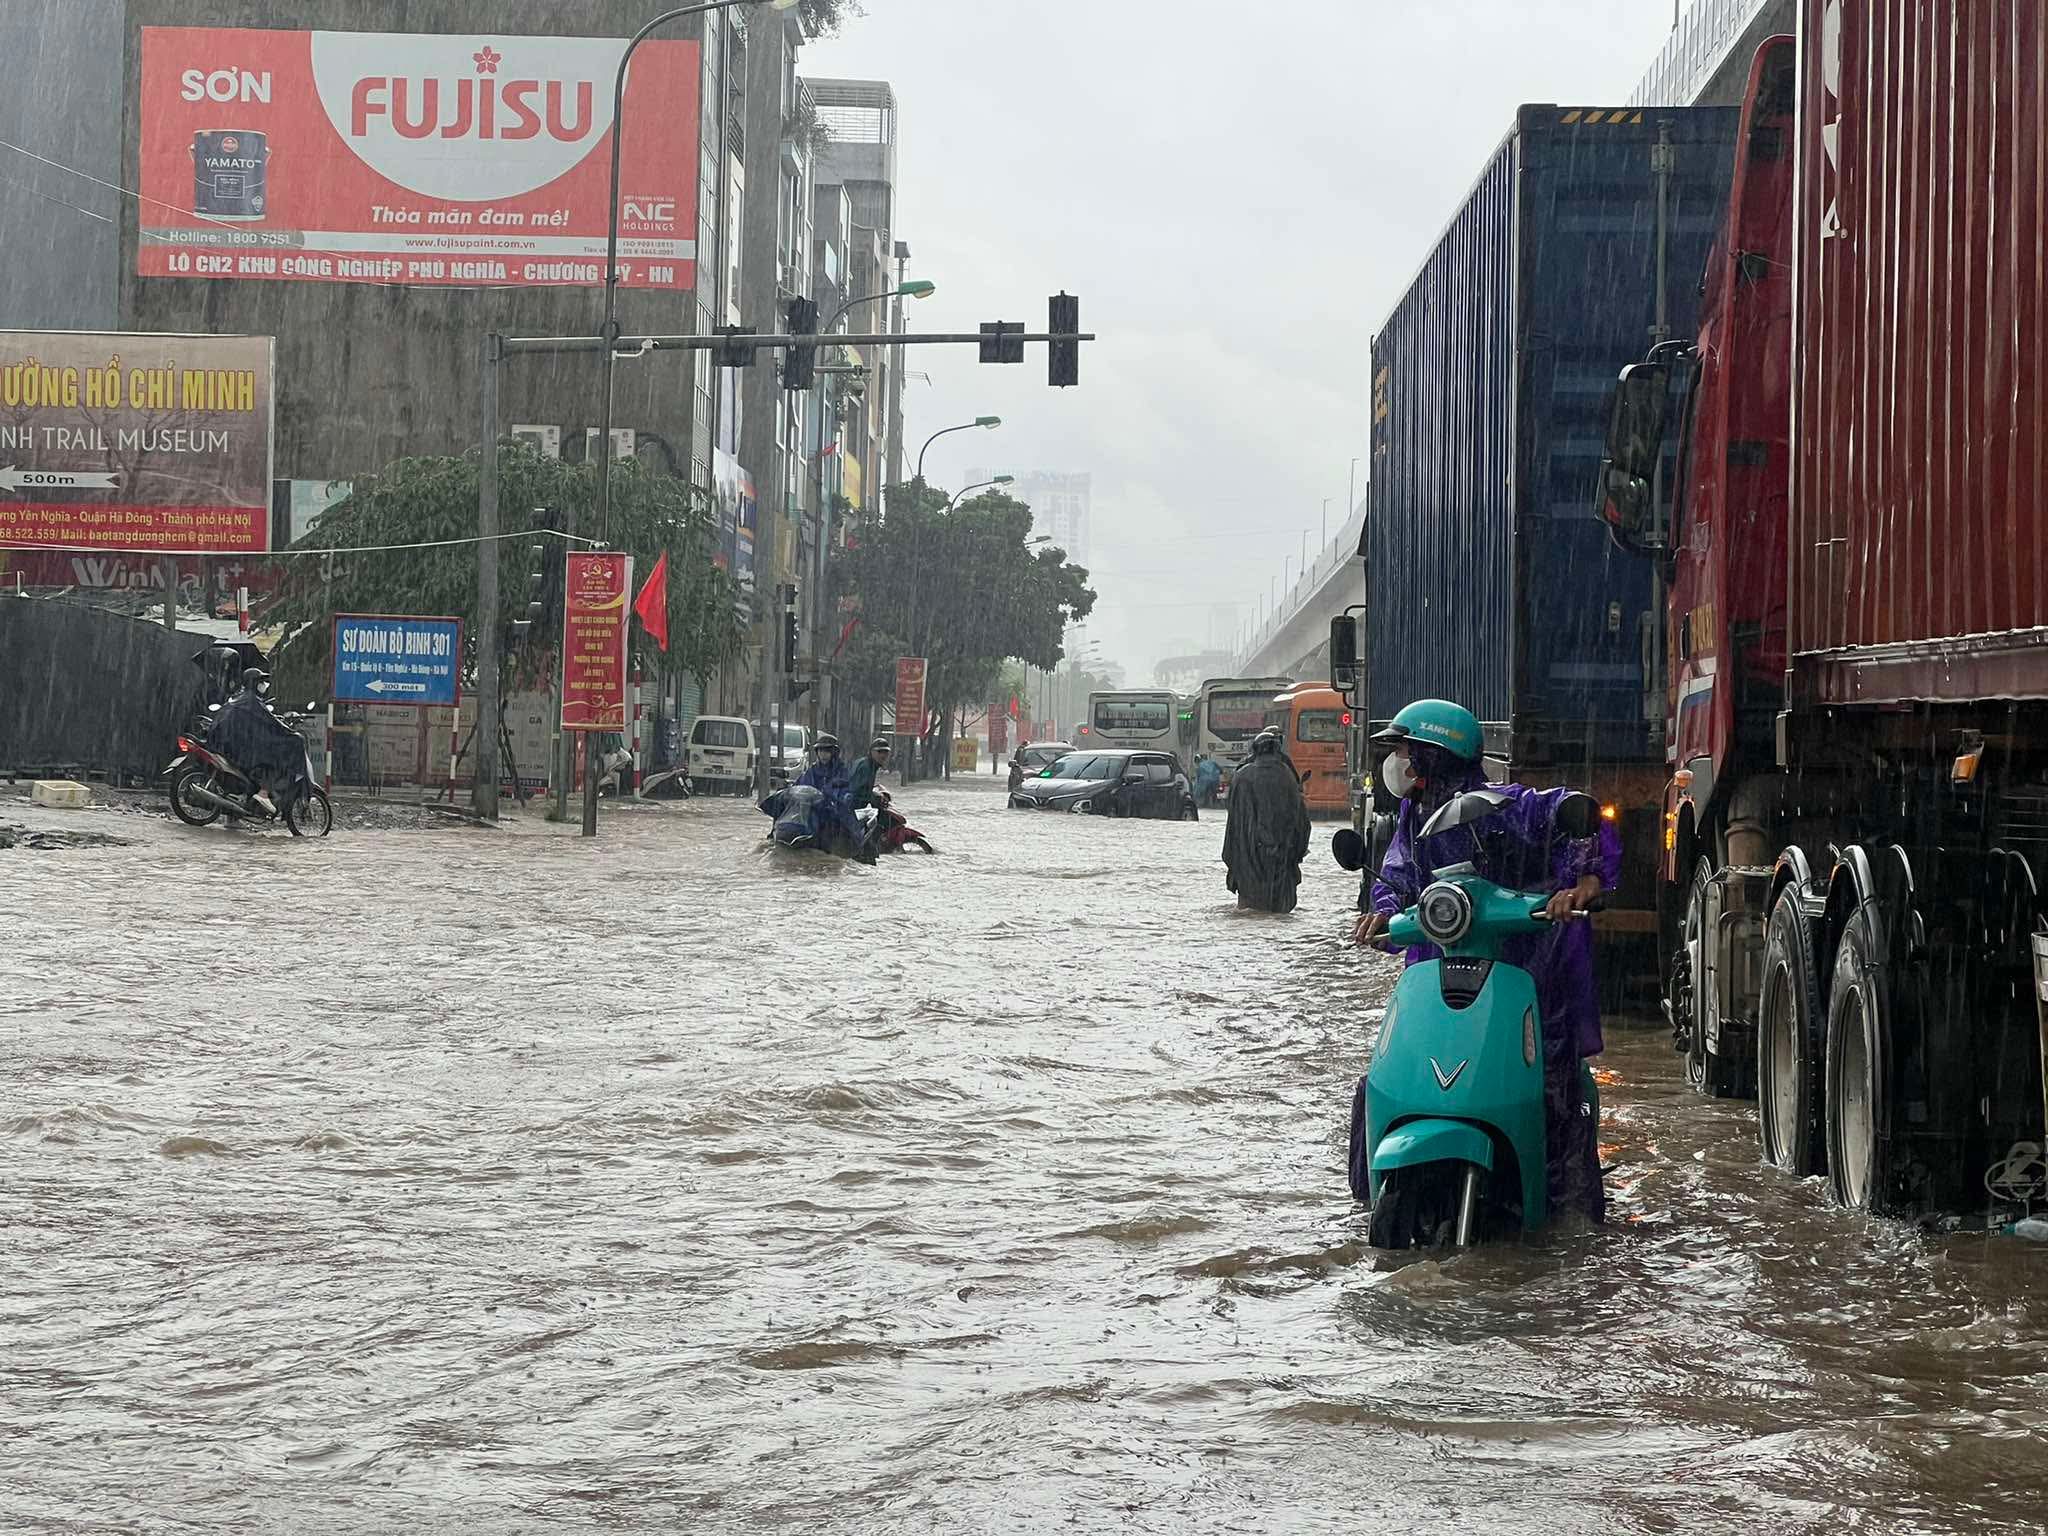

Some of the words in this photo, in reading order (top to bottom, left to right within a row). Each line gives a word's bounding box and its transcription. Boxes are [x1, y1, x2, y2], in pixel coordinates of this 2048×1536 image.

[181, 66, 271, 103] SƠN
[351, 77, 593, 142] FUJISU
[205, 158, 255, 169] YAMATO
[371, 206, 420, 224] Thỏa
[479, 208, 524, 225] đam
[531, 209, 570, 227] mê!
[623, 222, 675, 231] HOLDINGS
[169, 231, 221, 243] Hotline:
[227, 232, 256, 244] 1800
[261, 233, 290, 245] 9051
[405, 238, 536, 249] www.fujisupaint.com.vn
[169, 252, 190, 272] LÔ
[195, 255, 233, 273] CN2
[238, 256, 276, 274] KHU
[282, 255, 332, 276] CÔNG
[338, 257, 402, 279] NGHIỆP
[408, 258, 445, 278] PHÚ
[451, 259, 507, 279] NGHĨA
[523, 261, 598, 281] CHƯƠNG
[649, 265, 674, 283] HN
[0, 357, 79, 408] ƯỜNG
[128, 360, 176, 410] CHÍ
[182, 369, 255, 410] MINH
[42, 427, 109, 450] TRAIL
[118, 429, 229, 453] MUSEUM
[23, 474, 75, 485] 500m
[19, 509, 39, 521] Yên
[79, 511, 107, 525] Quận
[109, 511, 123, 523] Hà
[125, 511, 153, 526] Đông
[161, 512, 194, 525] Thành
[218, 513, 232, 525] Hà
[234, 513, 251, 528] Nội
[61, 529, 87, 540] Mail:
[89, 528, 252, 544] baotangduonghcm@gmail.com
[343, 627, 359, 653] SƯ
[359, 625, 387, 654] ĐOÀN
[389, 626, 403, 659] BỘ
[405, 631, 431, 655] BINH
[432, 633, 450, 656] 301
